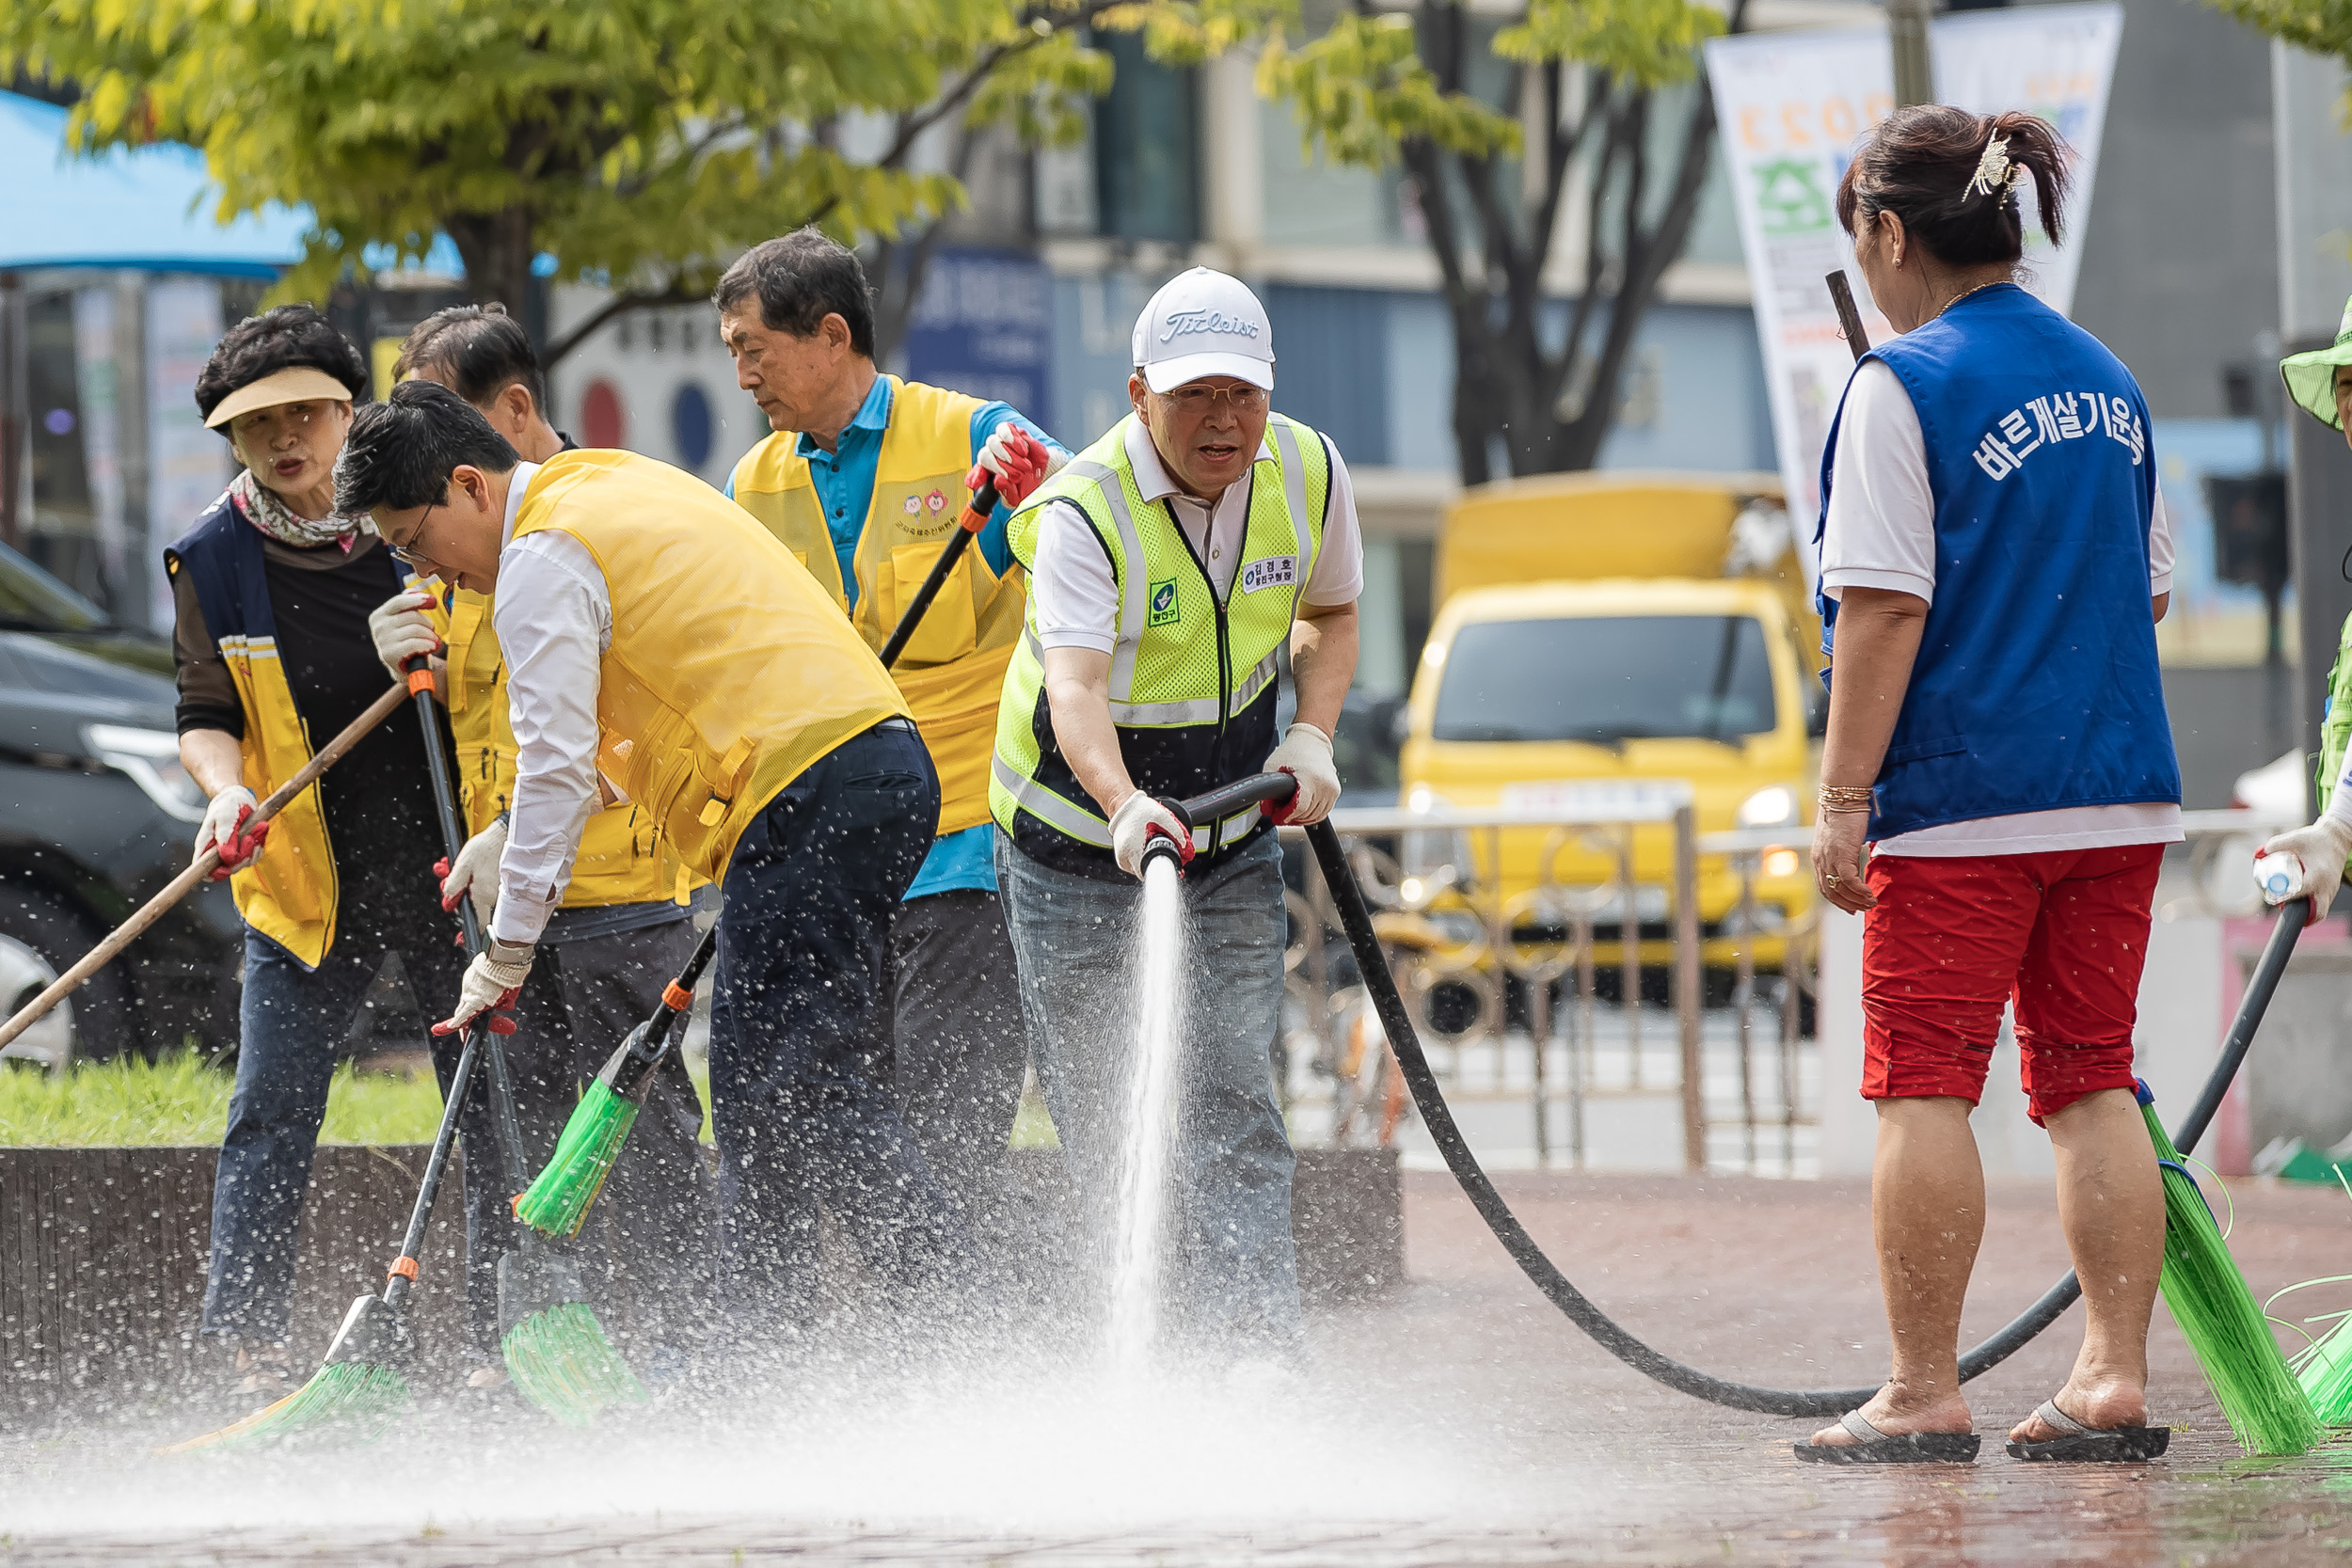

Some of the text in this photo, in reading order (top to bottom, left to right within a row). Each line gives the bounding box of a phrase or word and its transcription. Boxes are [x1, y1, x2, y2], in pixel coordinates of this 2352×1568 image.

[1159, 308, 1260, 344] Titleist
[1972, 391, 2145, 482] 바르게살기운동
[1152, 609, 1176, 623] 광진구
